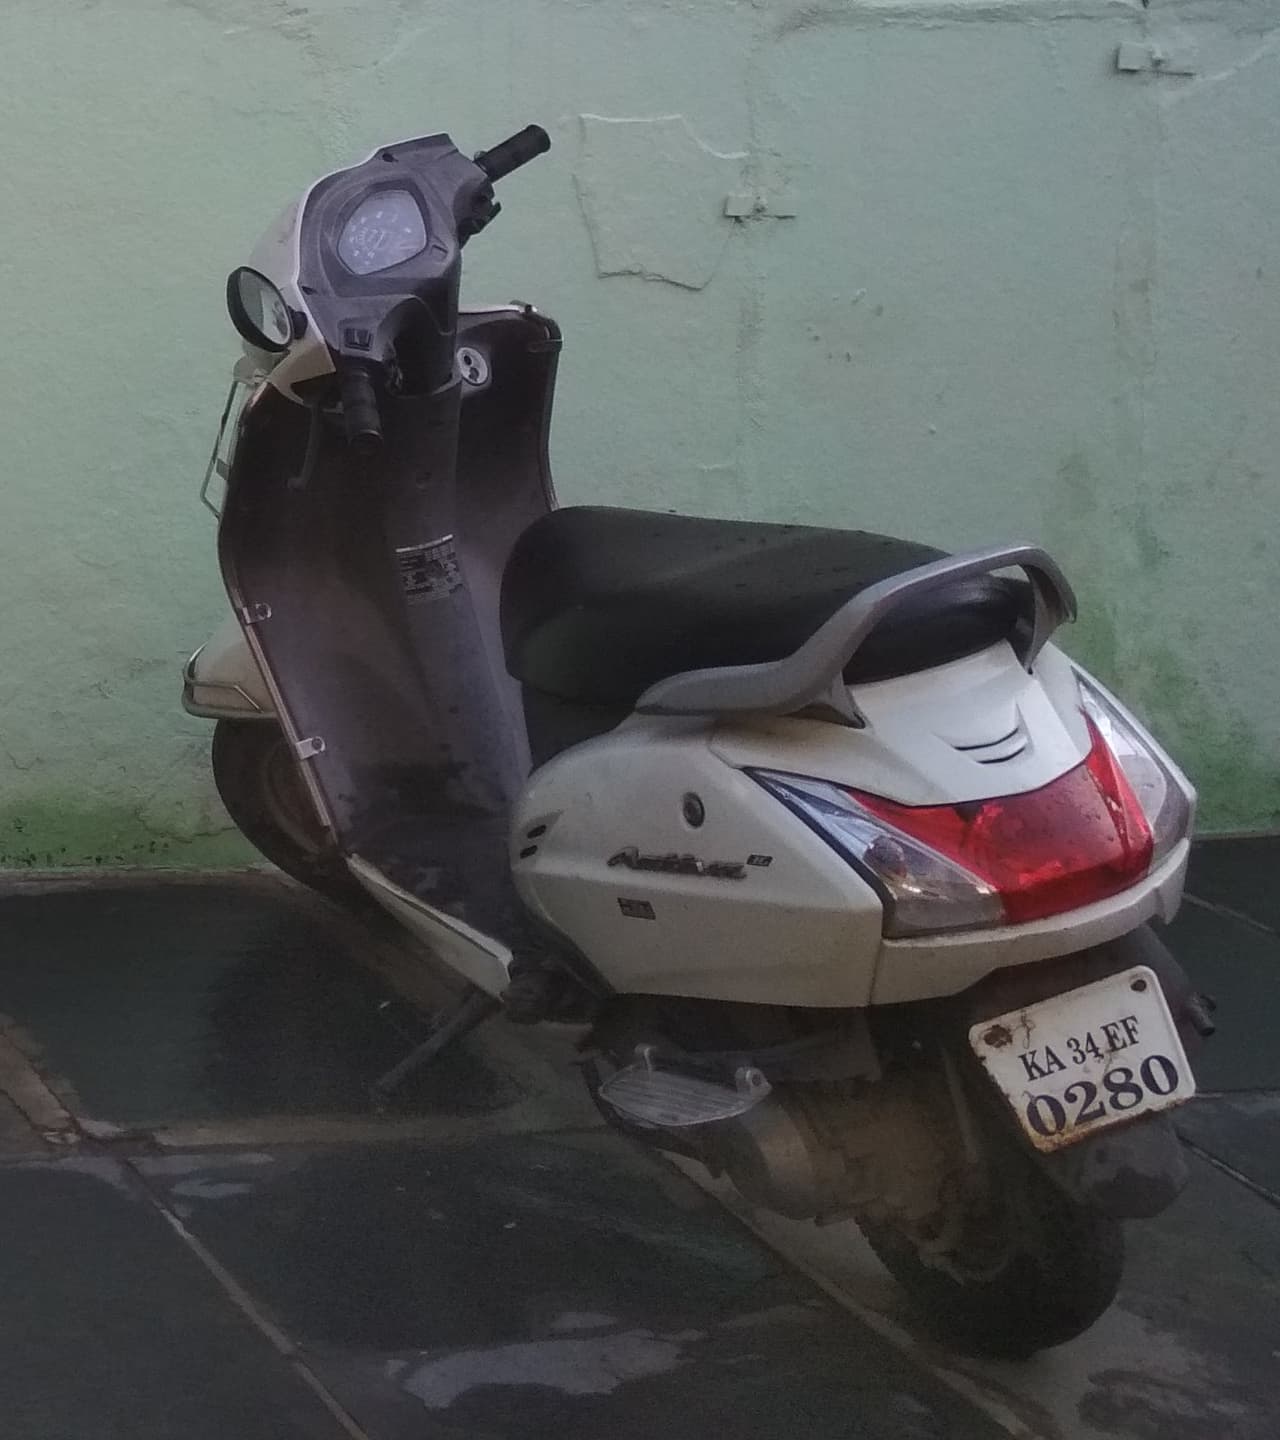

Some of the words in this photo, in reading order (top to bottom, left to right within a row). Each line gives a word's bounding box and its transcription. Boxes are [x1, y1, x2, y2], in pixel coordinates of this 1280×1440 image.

[1017, 1045, 1067, 1082] KA
[1066, 1031, 1105, 1065] 34
[1100, 1015, 1141, 1052] EF
[1025, 1054, 1180, 1138] 0280
